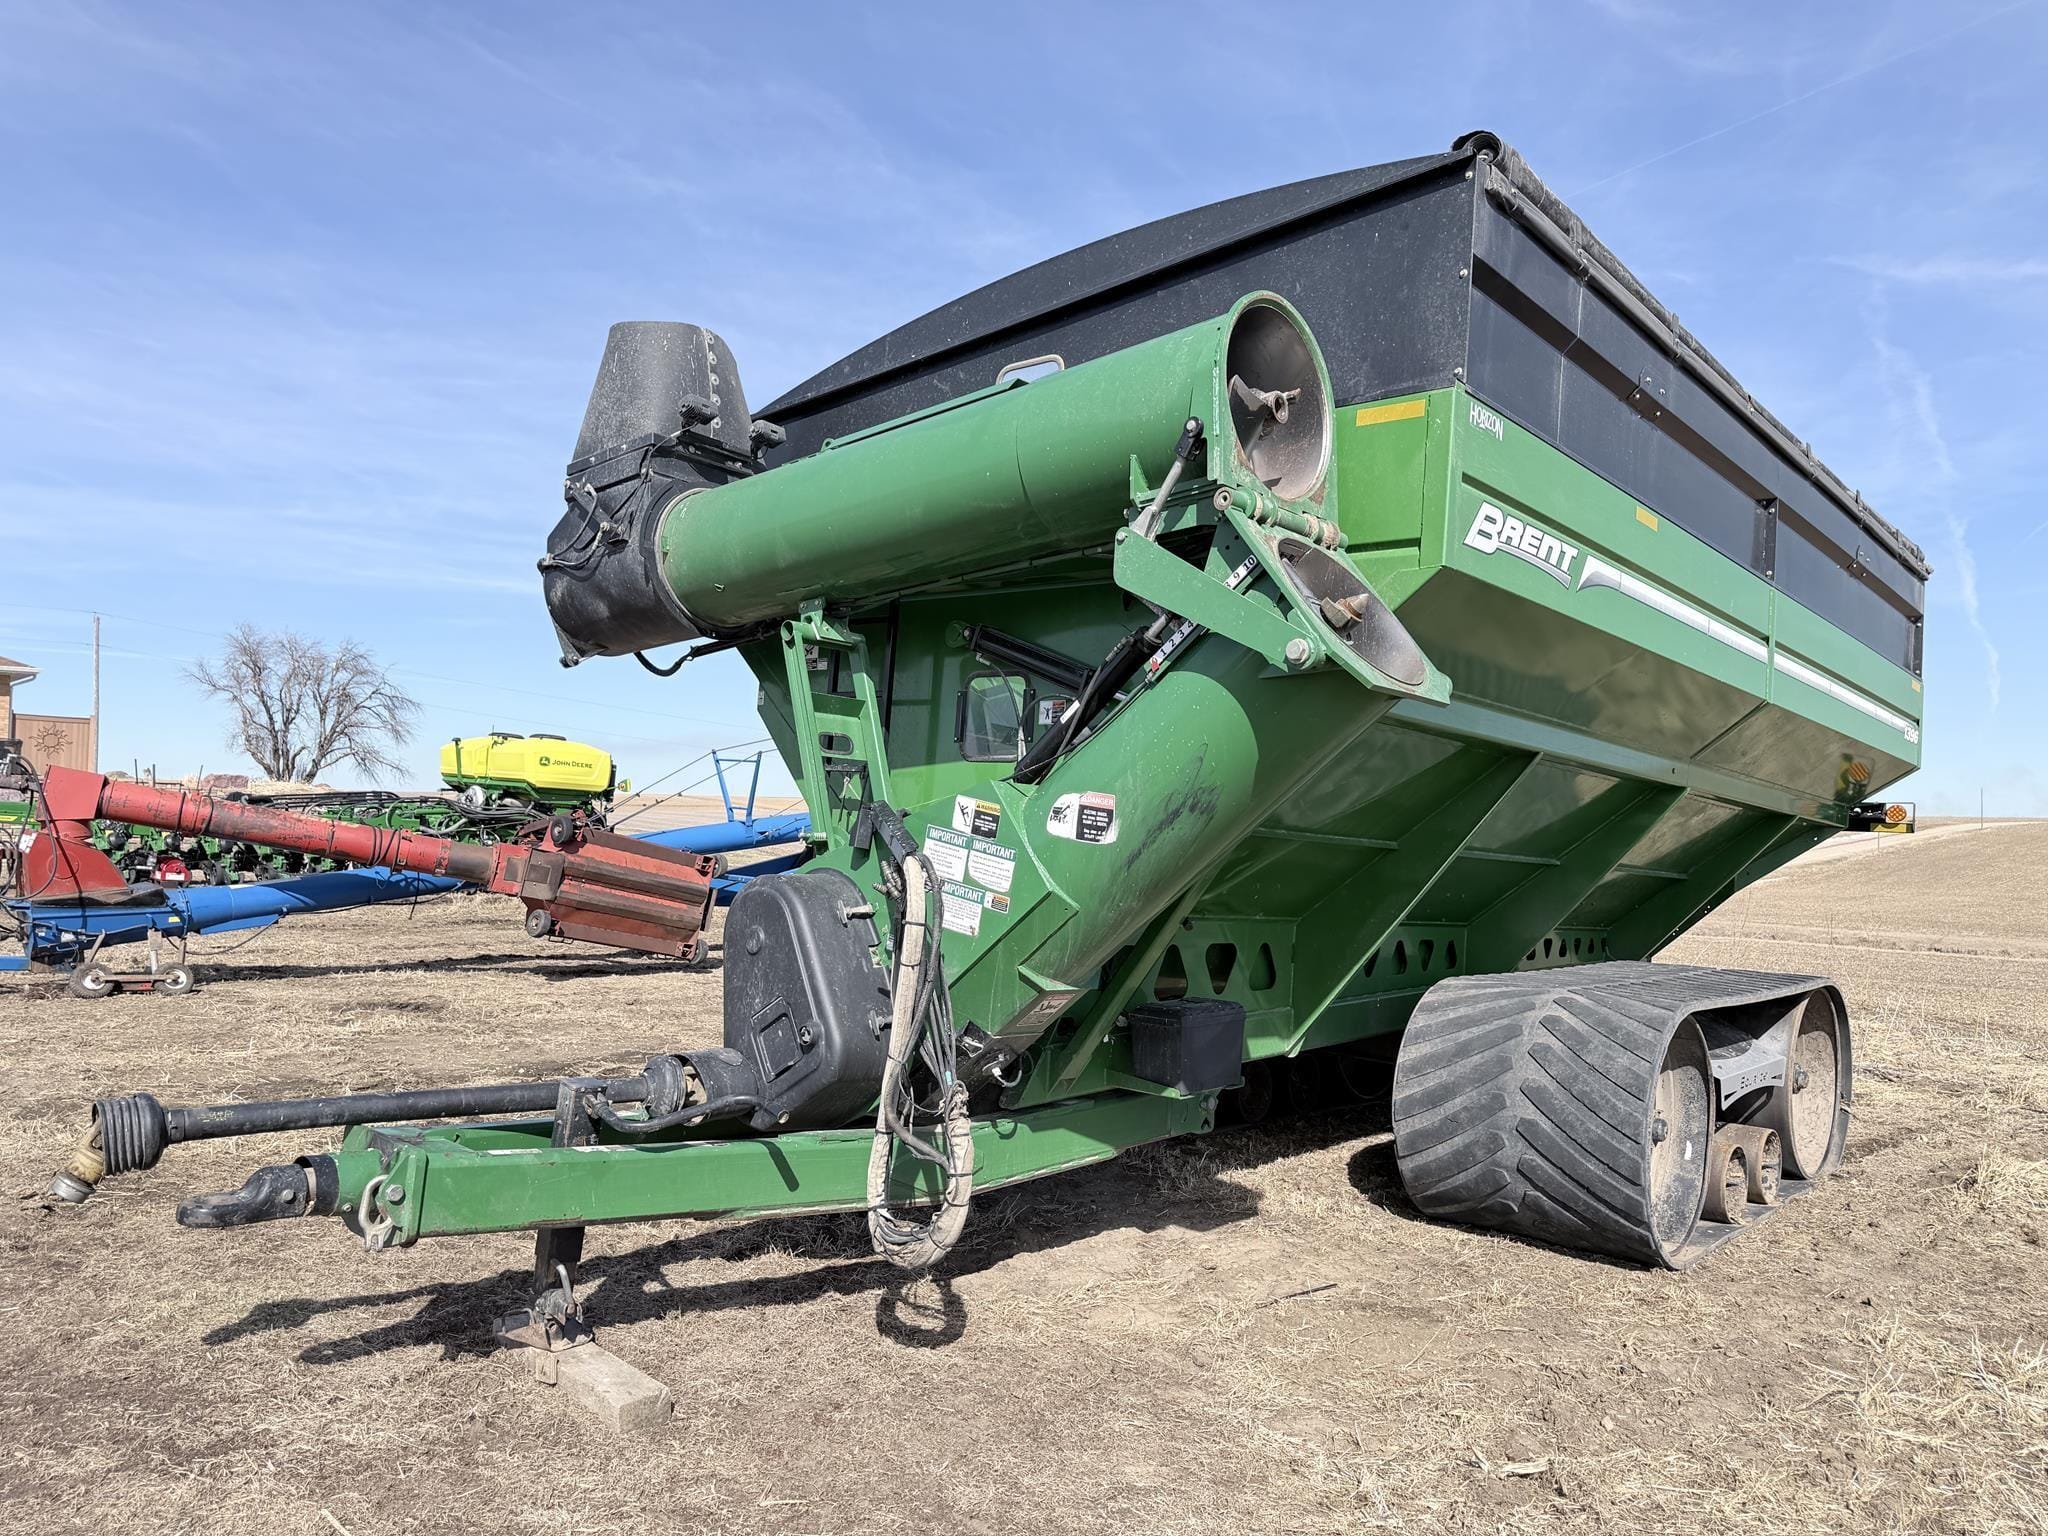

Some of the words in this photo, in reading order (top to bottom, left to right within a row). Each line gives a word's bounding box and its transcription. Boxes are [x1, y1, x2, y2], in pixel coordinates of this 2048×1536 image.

[1469, 401, 1504, 441] HORIZON
[1463, 500, 1579, 576] BRENT
[1160, 649, 1167, 657] 1
[1169, 638, 1177, 648] 2
[1178, 629, 1185, 639] 3
[1187, 620, 1194, 629] 4
[1233, 571, 1240, 581] 9
[1243, 556, 1255, 571] 10
[1087, 794, 1114, 806] DANGER
[929, 828, 968, 847] IMPORTANT
[972, 839, 1016, 860] IMPORTANT
